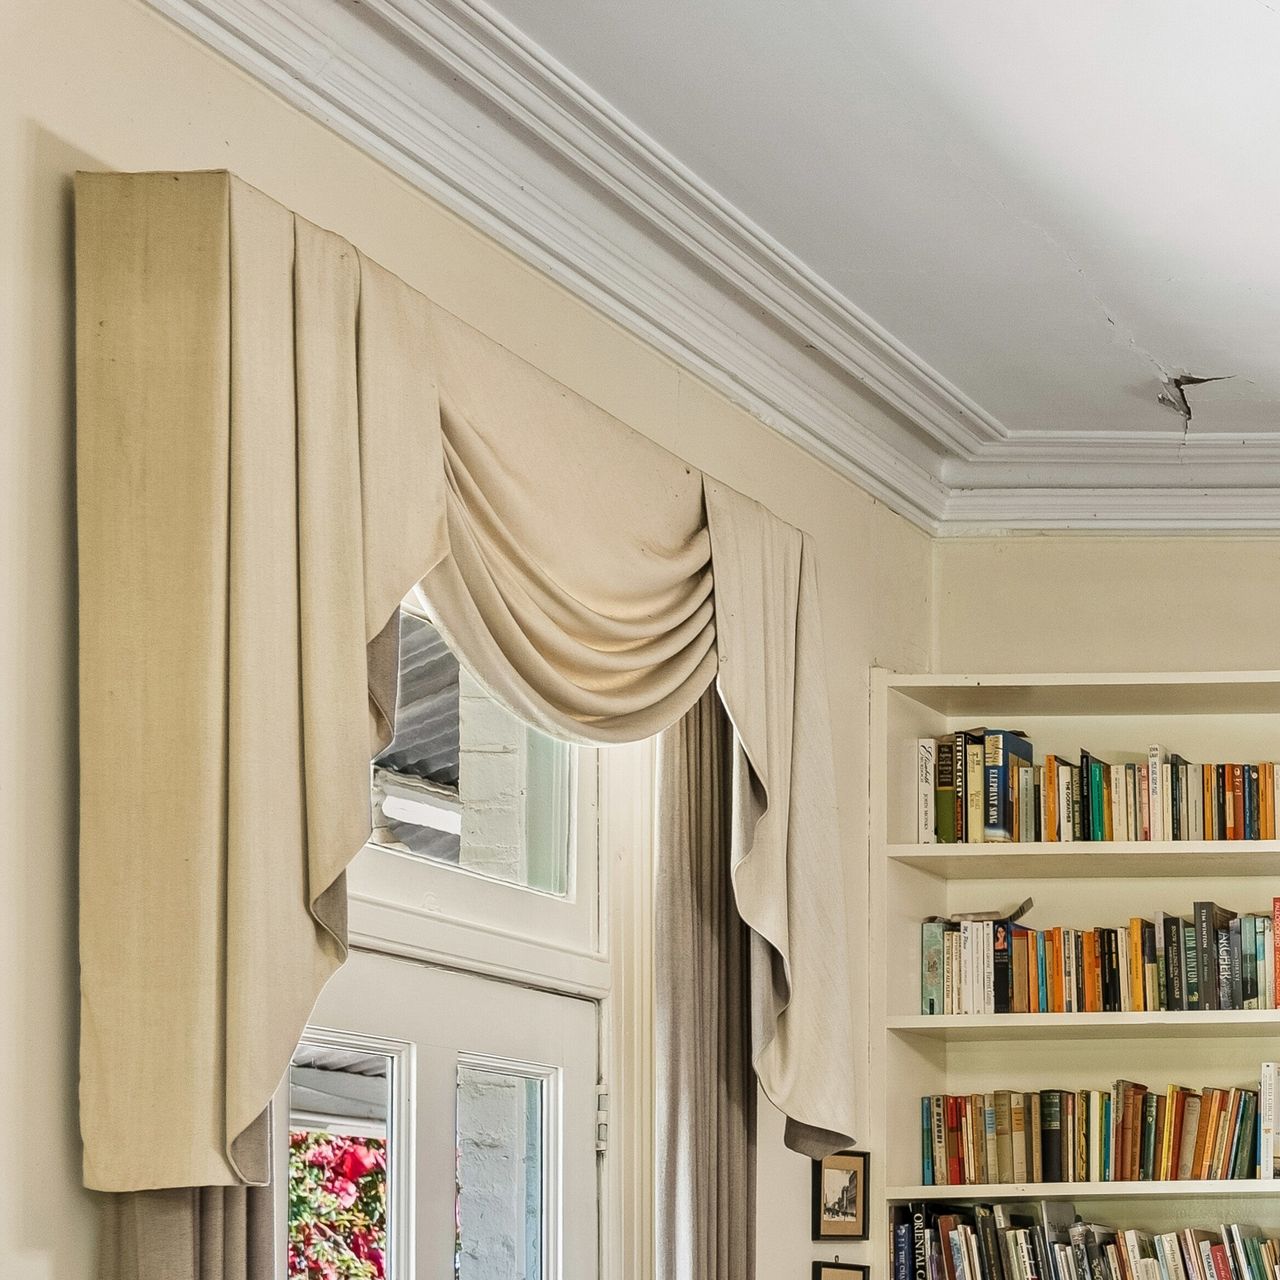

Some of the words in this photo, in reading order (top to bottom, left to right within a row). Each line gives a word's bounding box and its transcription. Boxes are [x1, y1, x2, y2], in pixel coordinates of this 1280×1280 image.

[989, 769, 998, 804] ELEPHANT
[989, 806, 998, 824] SONG
[1184, 932, 1196, 947] TIM
[1217, 932, 1230, 980] ARCHER
[1186, 950, 1198, 983] WINTON
[913, 1213, 925, 1269] ORIENTAL
